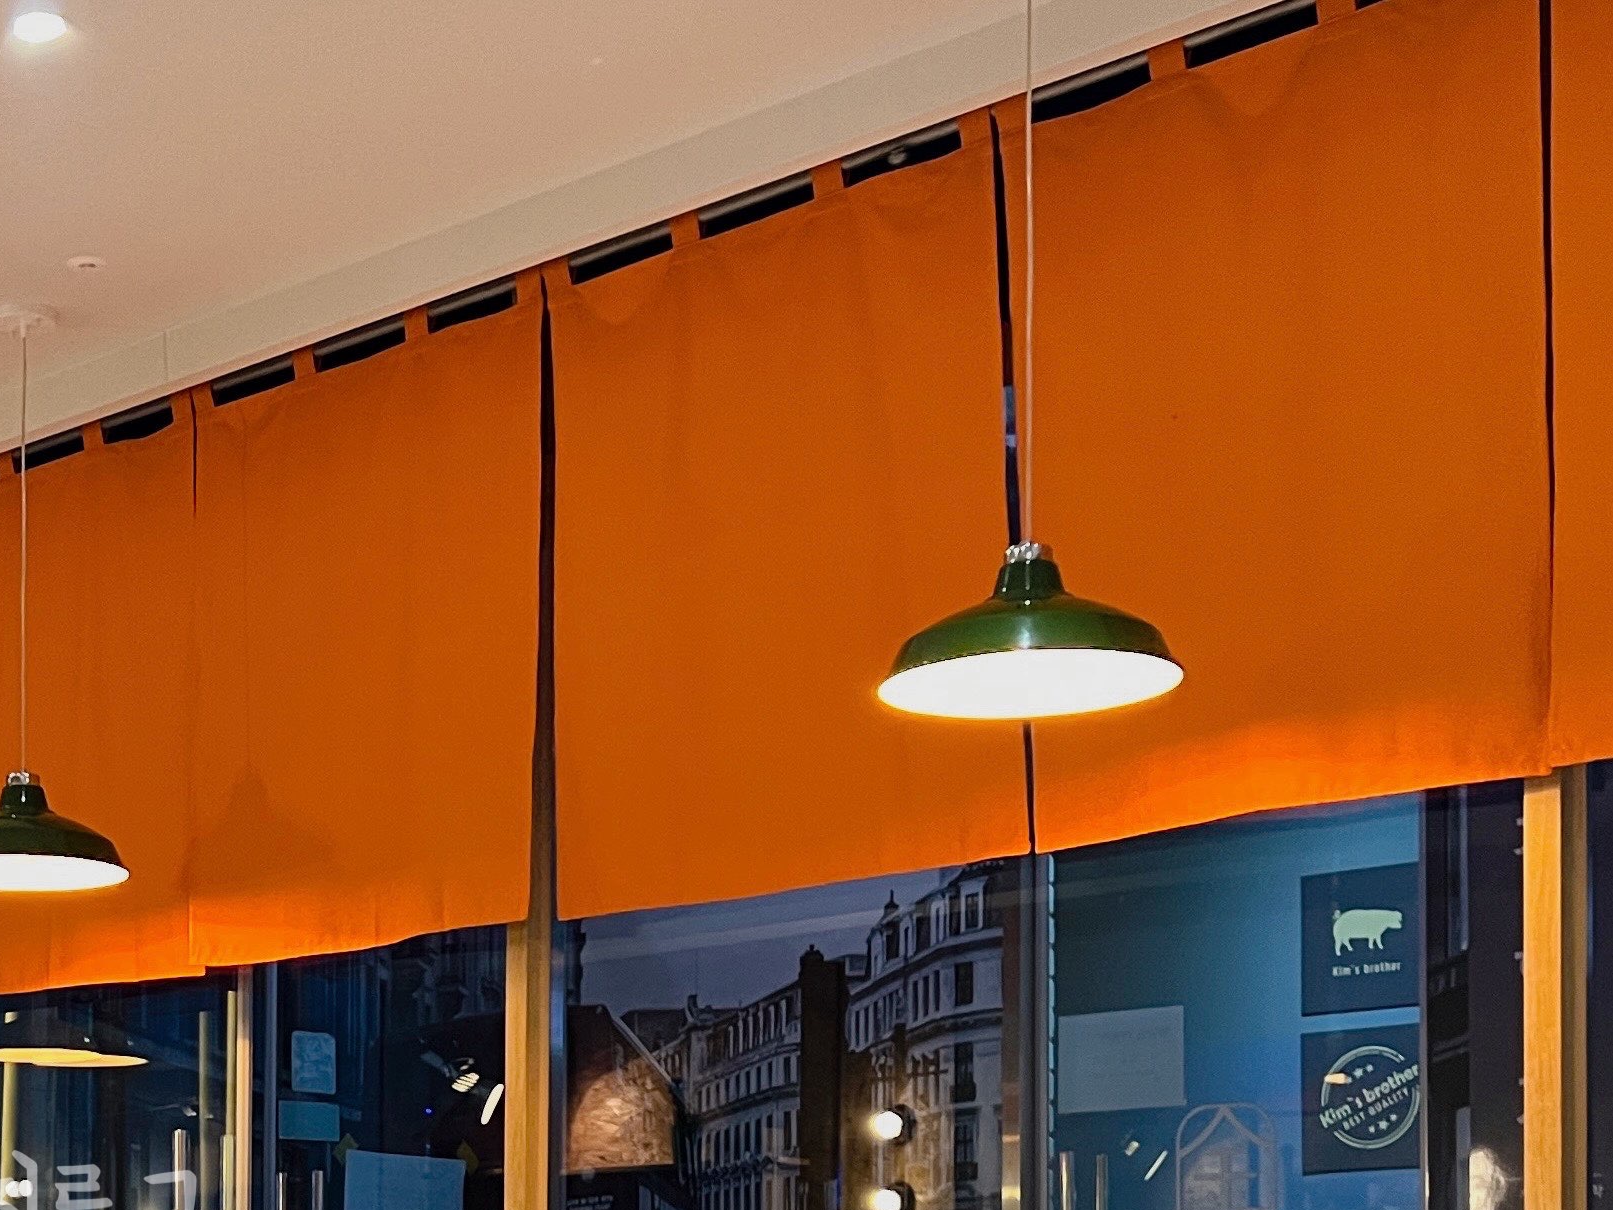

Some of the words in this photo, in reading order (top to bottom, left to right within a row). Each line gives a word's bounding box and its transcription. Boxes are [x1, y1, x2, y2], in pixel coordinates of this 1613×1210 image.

[1363, 961, 1401, 975] brother
[1361, 1063, 1419, 1103] brother
[1342, 1110, 1366, 1131] BEST
[1367, 1086, 1409, 1117] QUALITY
